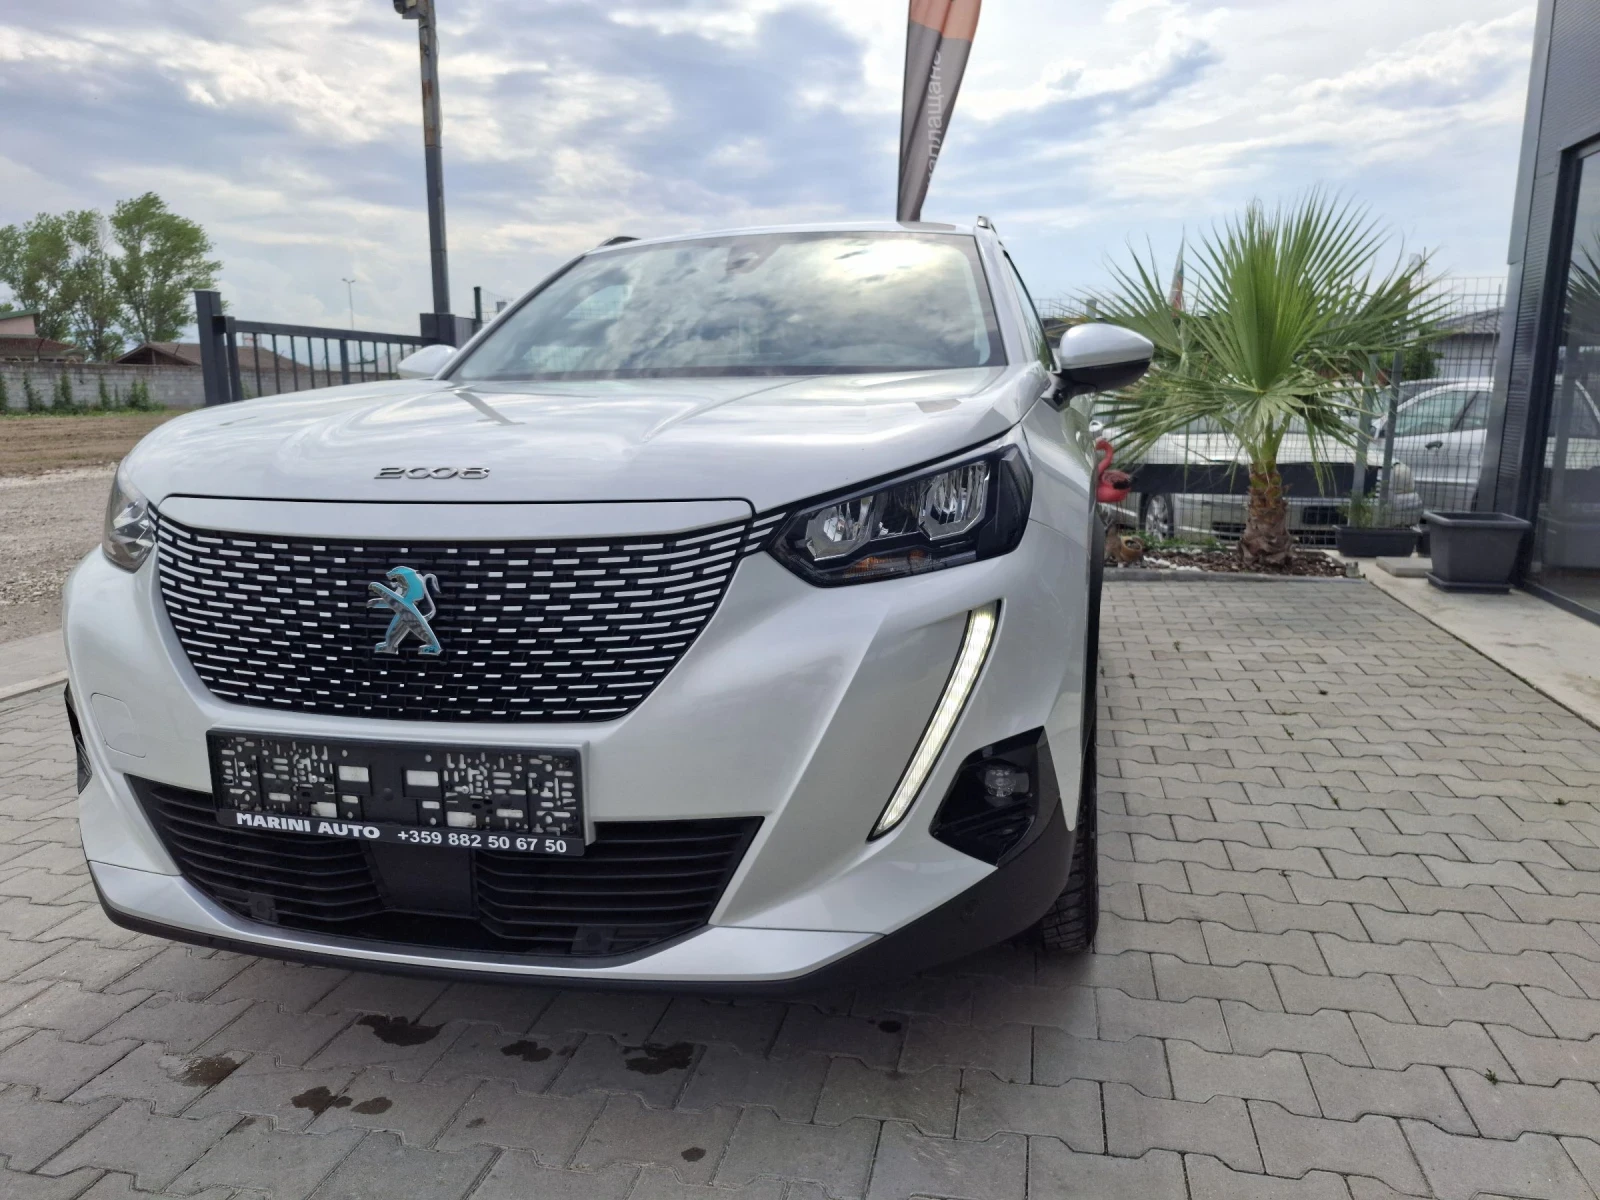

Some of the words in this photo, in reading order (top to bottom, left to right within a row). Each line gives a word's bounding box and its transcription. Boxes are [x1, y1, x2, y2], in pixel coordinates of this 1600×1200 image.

[927, 50, 945, 185] плащан
[373, 467, 490, 480] 2008
[236, 812, 311, 832] MARINI
[317, 821, 381, 839] AUTO
[397, 830, 442, 844] +359
[448, 833, 482, 847] 882
[488, 836, 510, 849] 50
[516, 837, 538, 851] 67
[545, 839, 567, 853] 50
